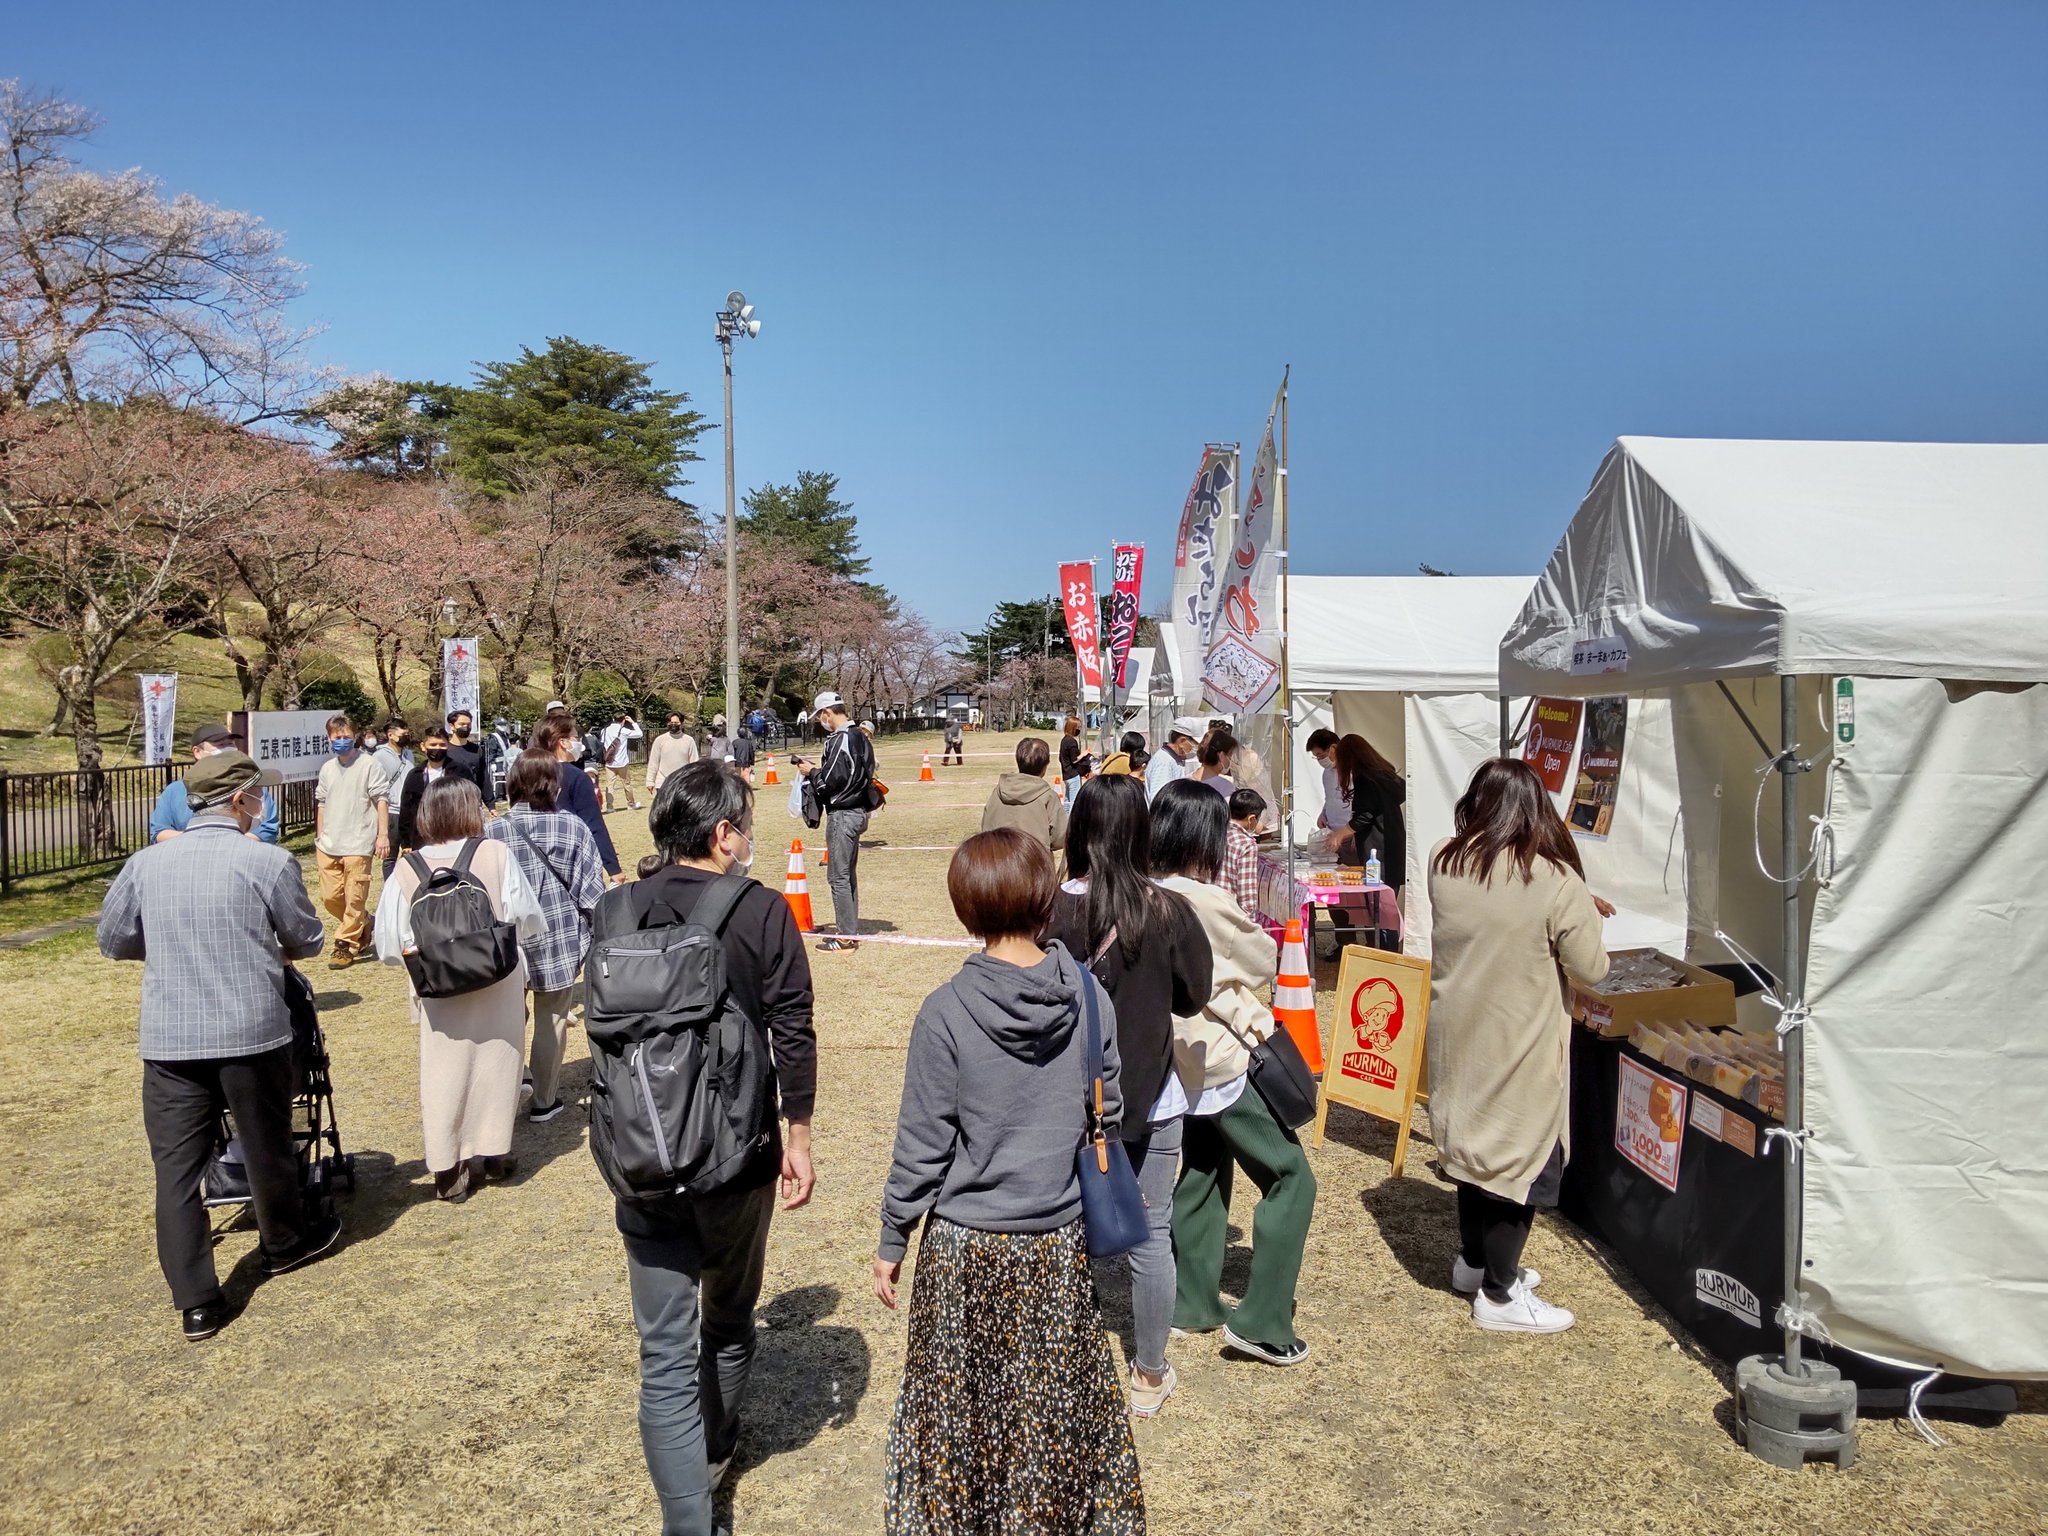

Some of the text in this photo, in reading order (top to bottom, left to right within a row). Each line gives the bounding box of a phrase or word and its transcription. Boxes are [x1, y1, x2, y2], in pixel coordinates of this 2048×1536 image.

[1067, 581, 1099, 673] お赤飯
[1538, 705, 1569, 722] Welcome
[260, 735, 331, 760] 五泉市陸上競技
[1544, 753, 1561, 773] Open
[1344, 1053, 1395, 1079] MURMUR
[1360, 1074, 1375, 1083] CAFE
[1698, 1272, 1756, 1312] MURMUR
